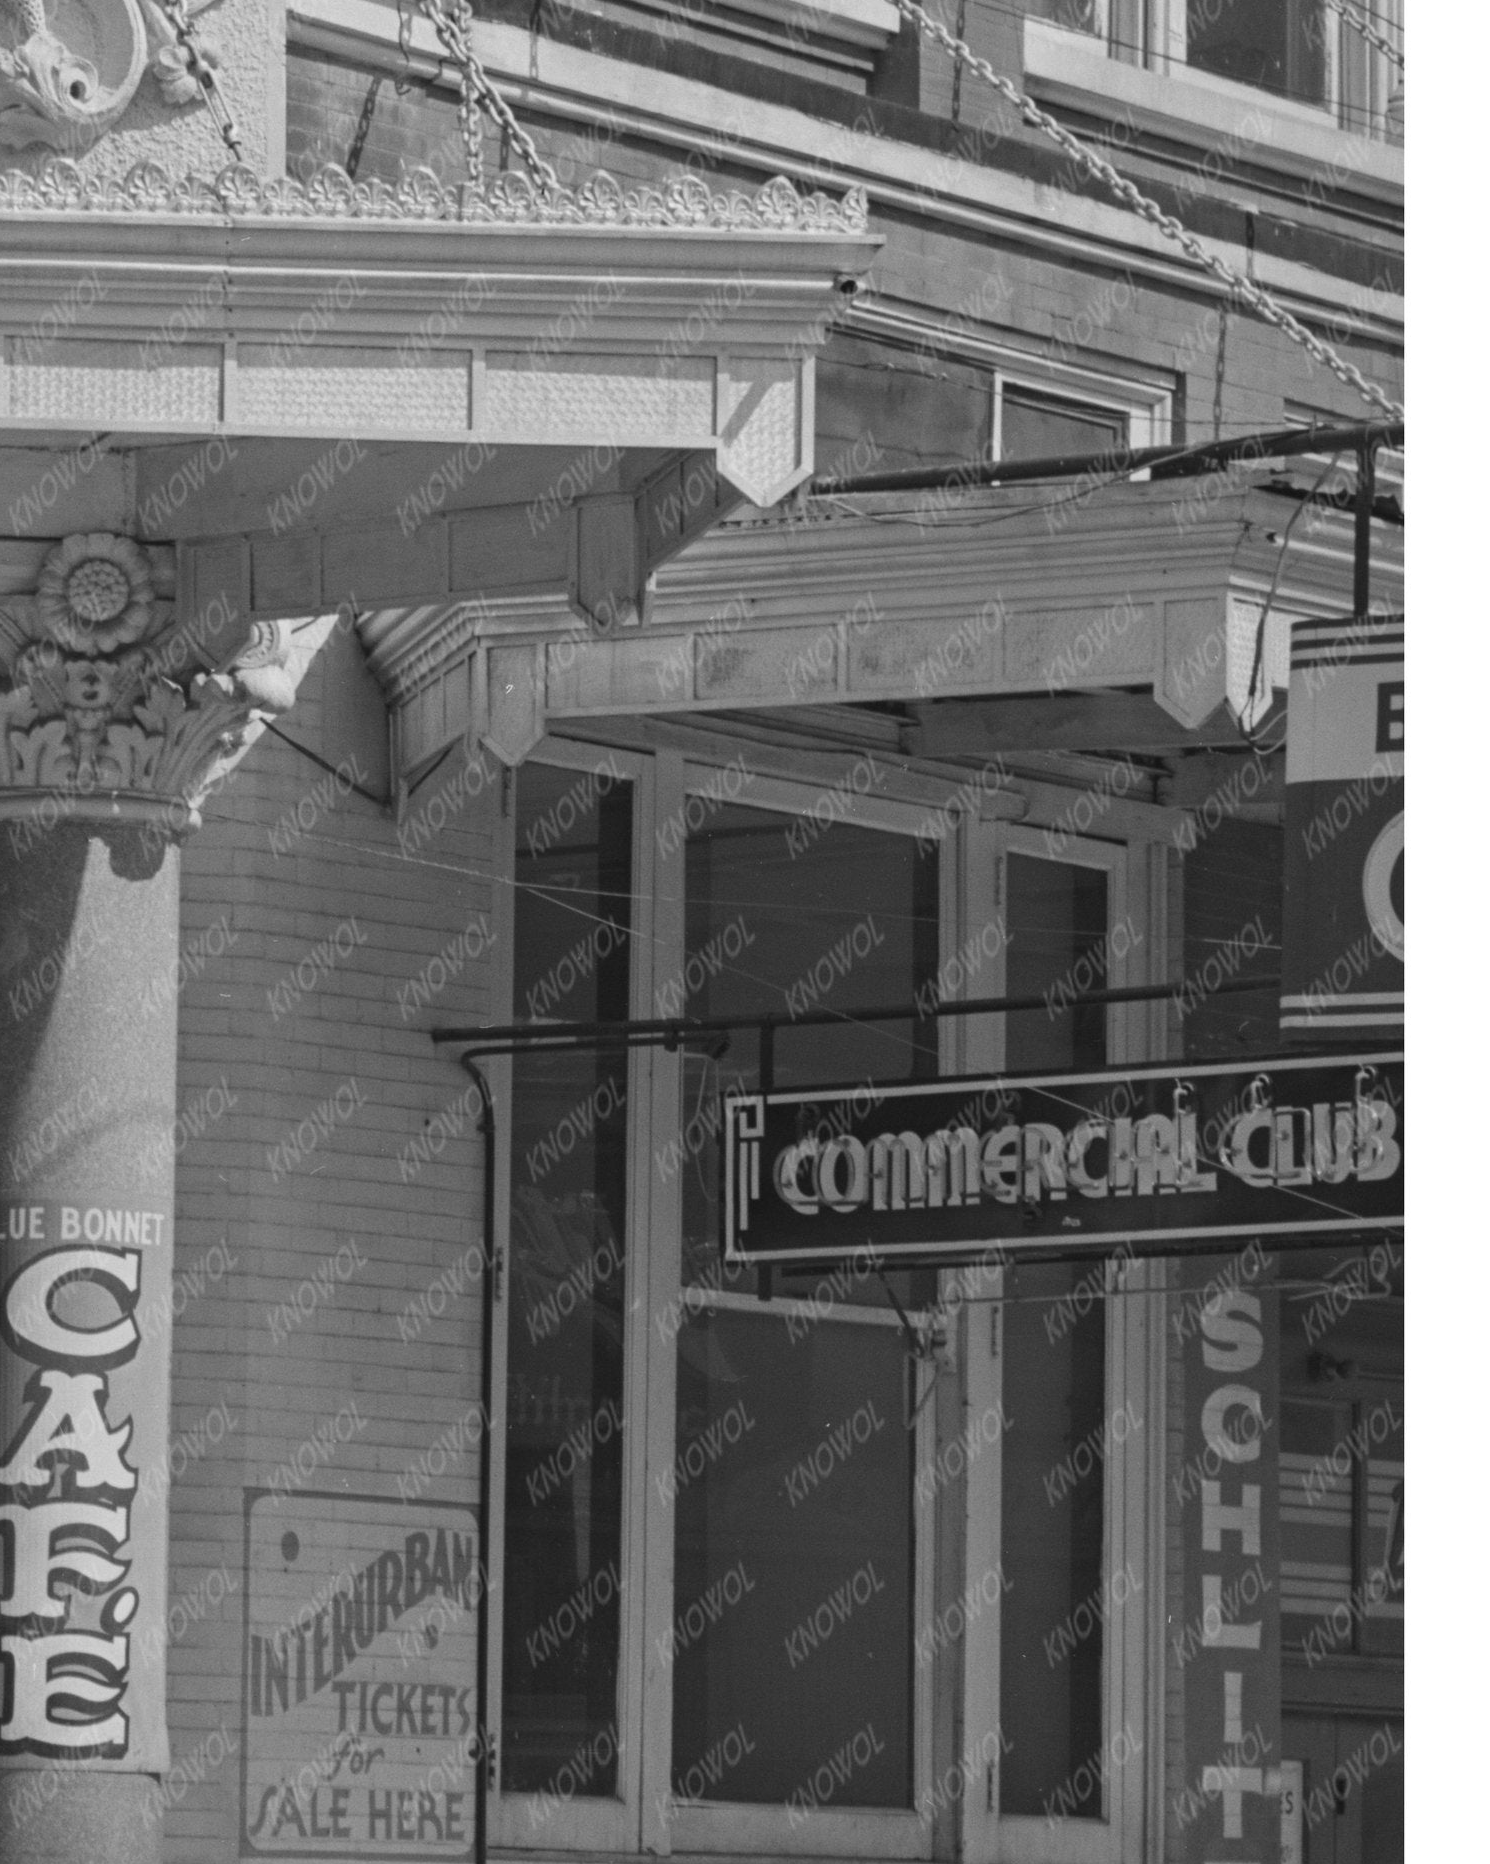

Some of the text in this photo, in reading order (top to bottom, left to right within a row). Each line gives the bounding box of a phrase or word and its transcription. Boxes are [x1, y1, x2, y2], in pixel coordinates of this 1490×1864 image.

[773, 1099, 1401, 1216] COMMERCIAL CLUB
[61, 1206, 166, 1246] BONNET
[249, 1527, 474, 1717] INTERURBAN
[332, 1681, 472, 1736] TICKETS
[327, 1740, 385, 1782] for
[248, 1785, 466, 1839] SALE HERE
